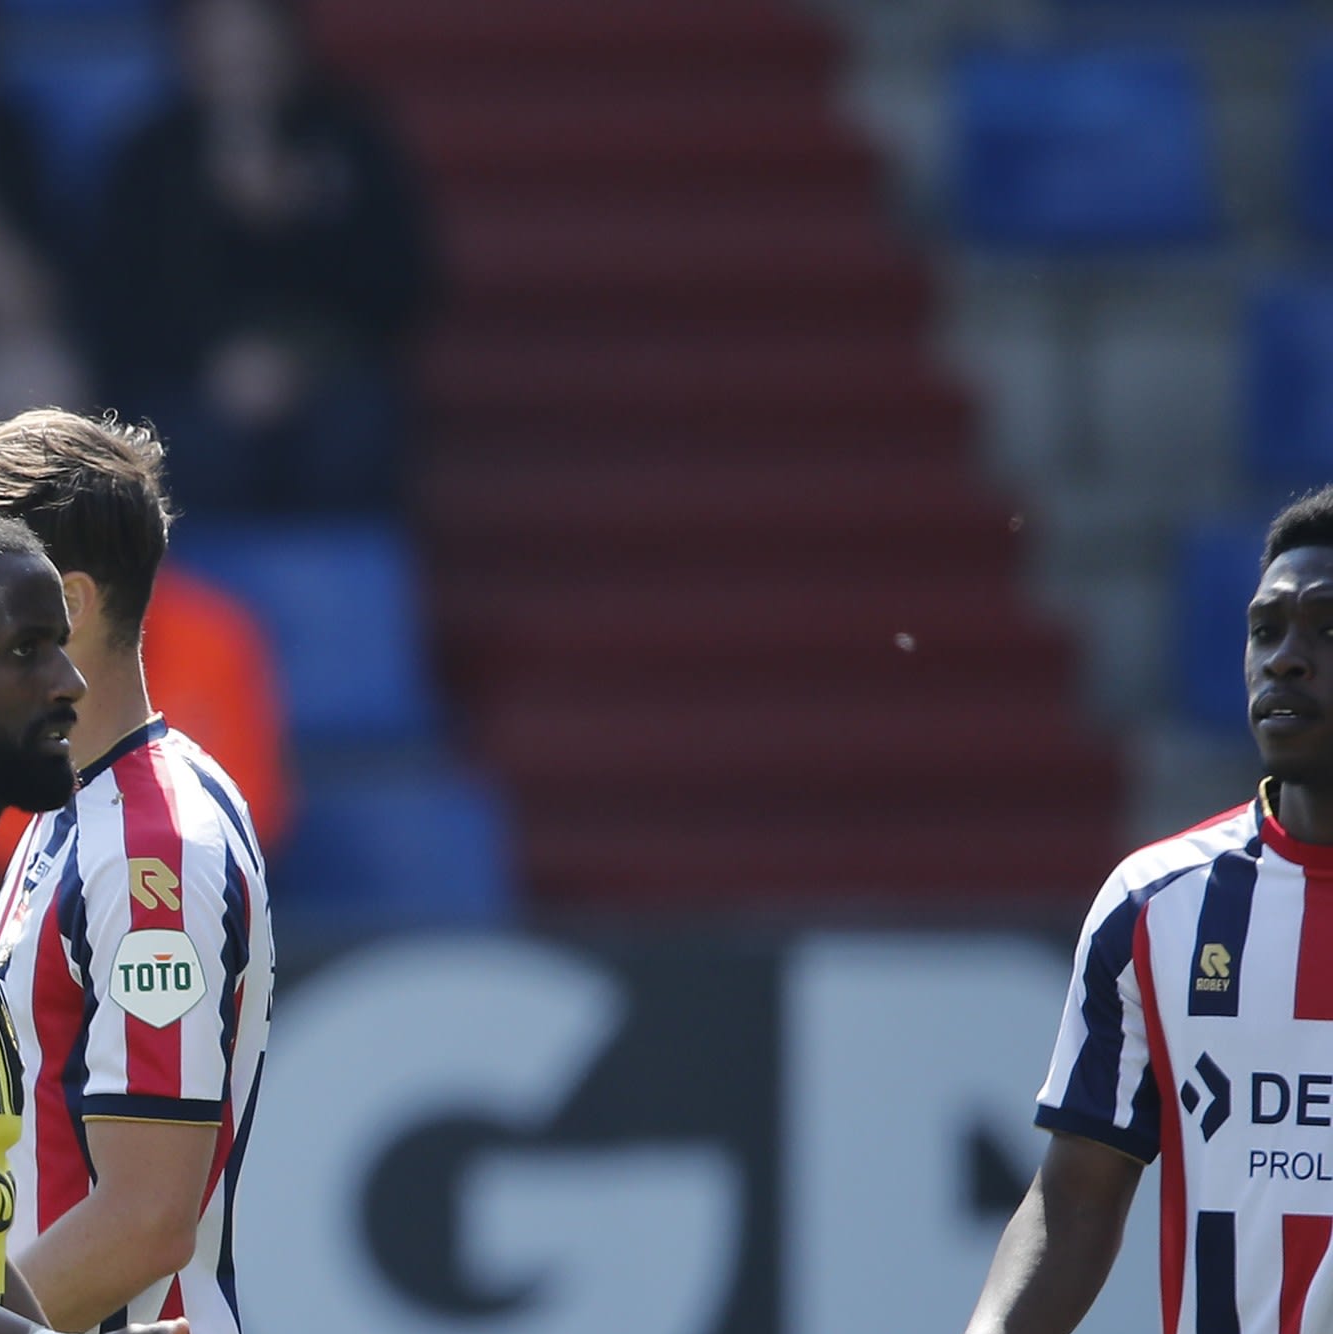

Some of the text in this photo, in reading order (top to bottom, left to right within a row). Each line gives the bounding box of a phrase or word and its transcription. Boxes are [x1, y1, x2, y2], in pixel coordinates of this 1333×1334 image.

[118, 962, 192, 993] TOTO
[1251, 1071, 1333, 1127] DE
[1249, 1149, 1333, 1182] PROL
